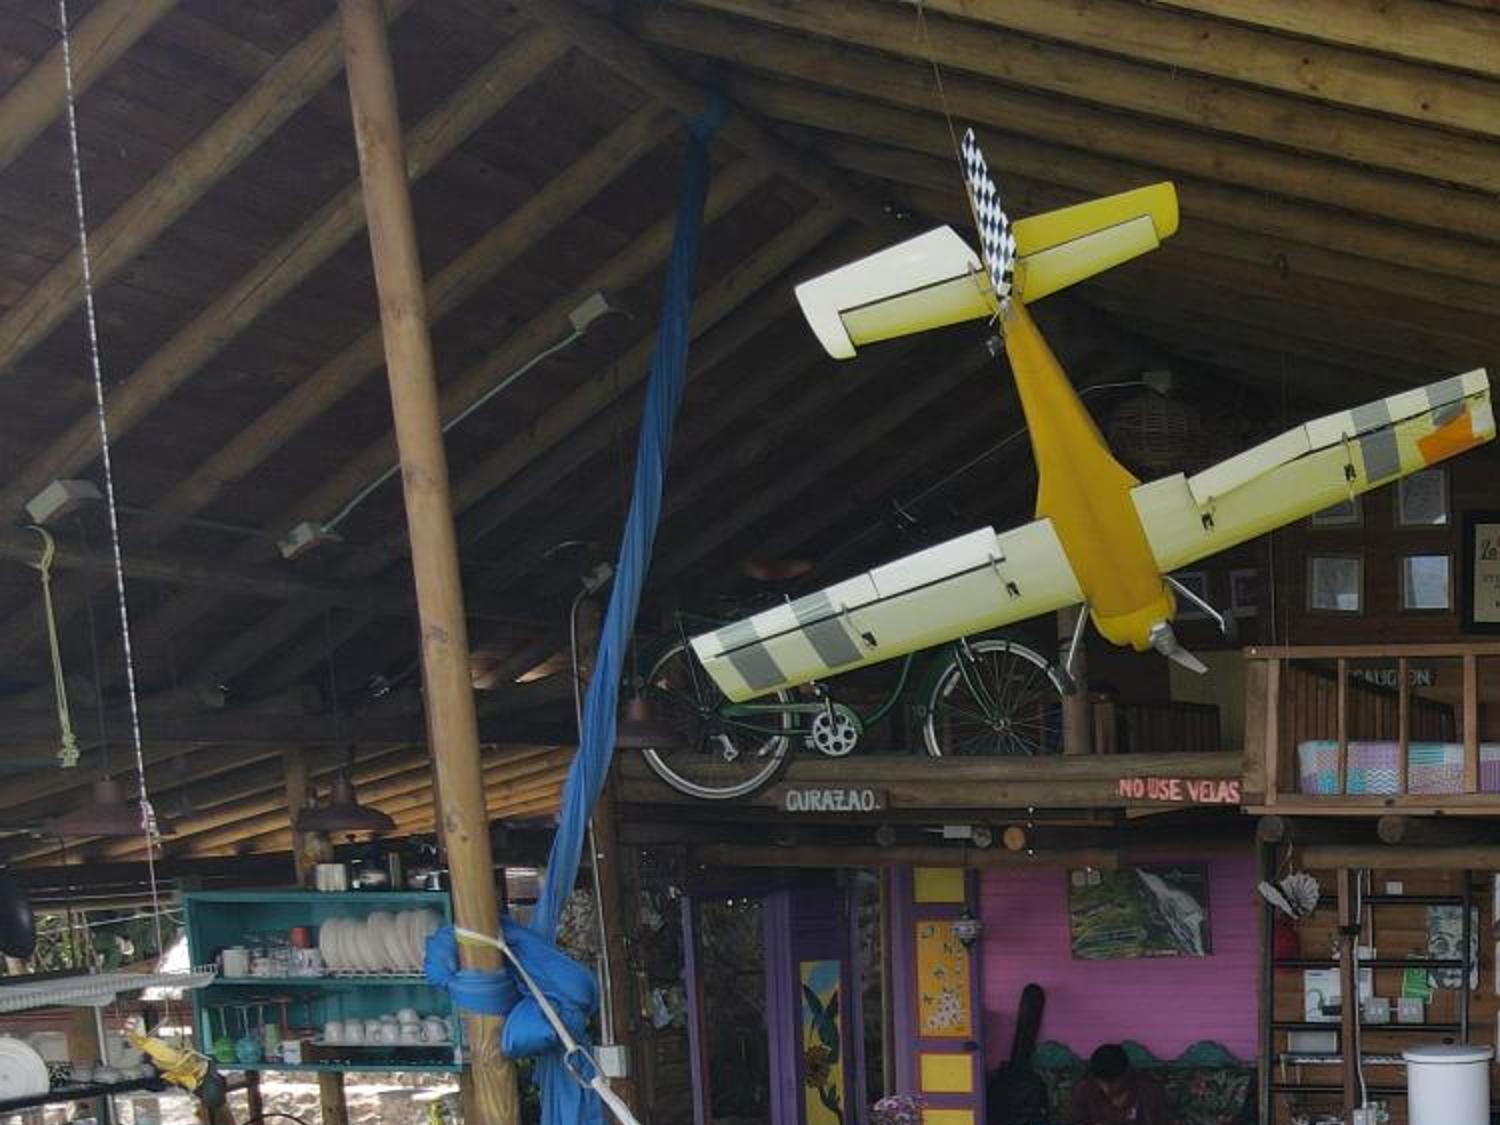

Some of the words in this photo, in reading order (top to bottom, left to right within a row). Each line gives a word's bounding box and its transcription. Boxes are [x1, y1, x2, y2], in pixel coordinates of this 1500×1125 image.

[1119, 779, 1145, 798] NO
[1147, 779, 1184, 801] USE
[1186, 780, 1241, 804] VELAS
